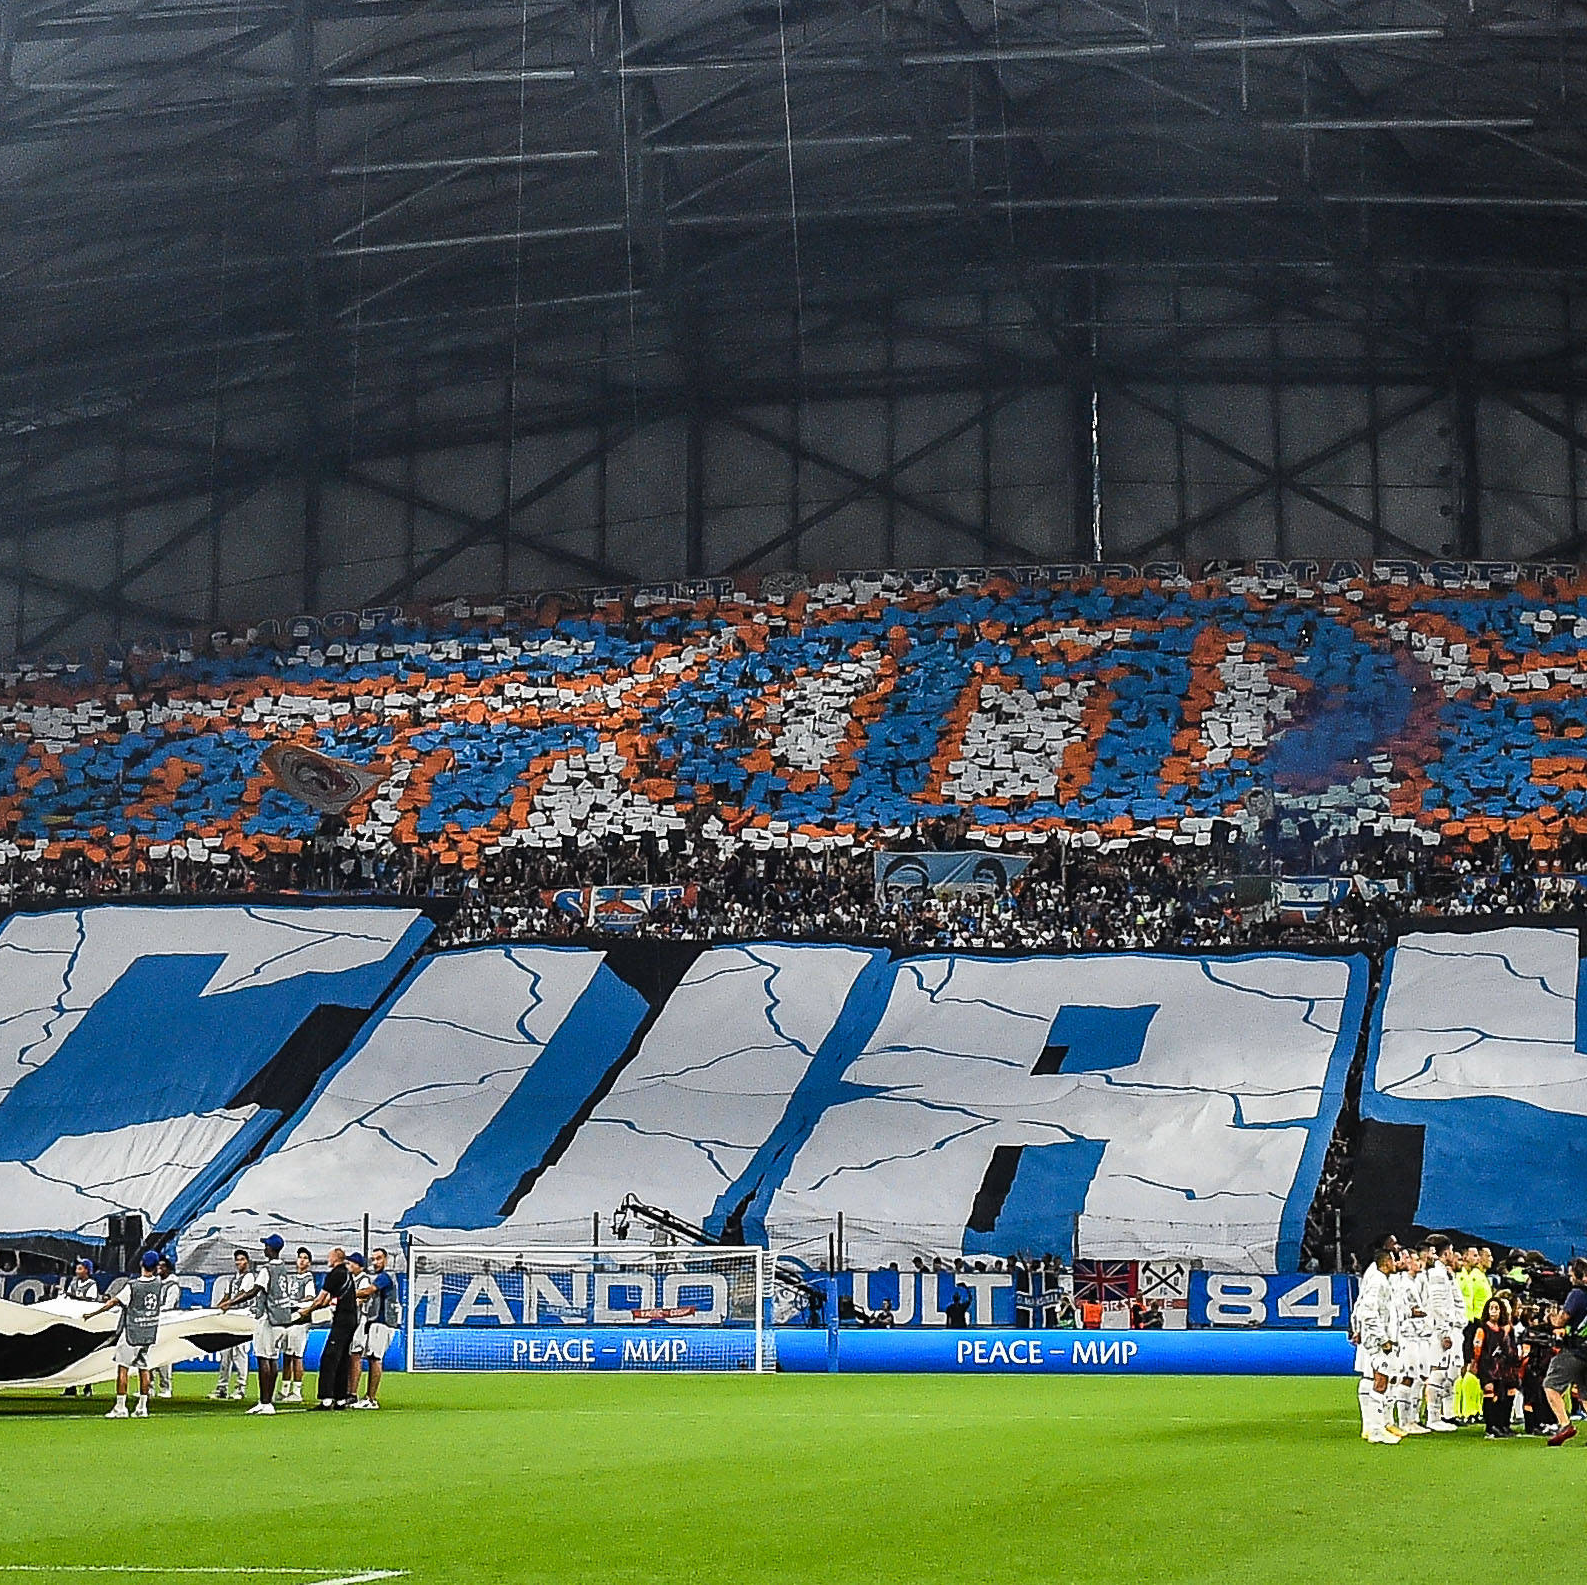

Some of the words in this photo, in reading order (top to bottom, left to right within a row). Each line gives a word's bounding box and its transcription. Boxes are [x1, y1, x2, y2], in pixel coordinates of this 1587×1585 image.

[1205, 1274, 1341, 1327] 84
[513, 1339, 596, 1363] PEACE
[956, 1339, 1044, 1365] PEACE
